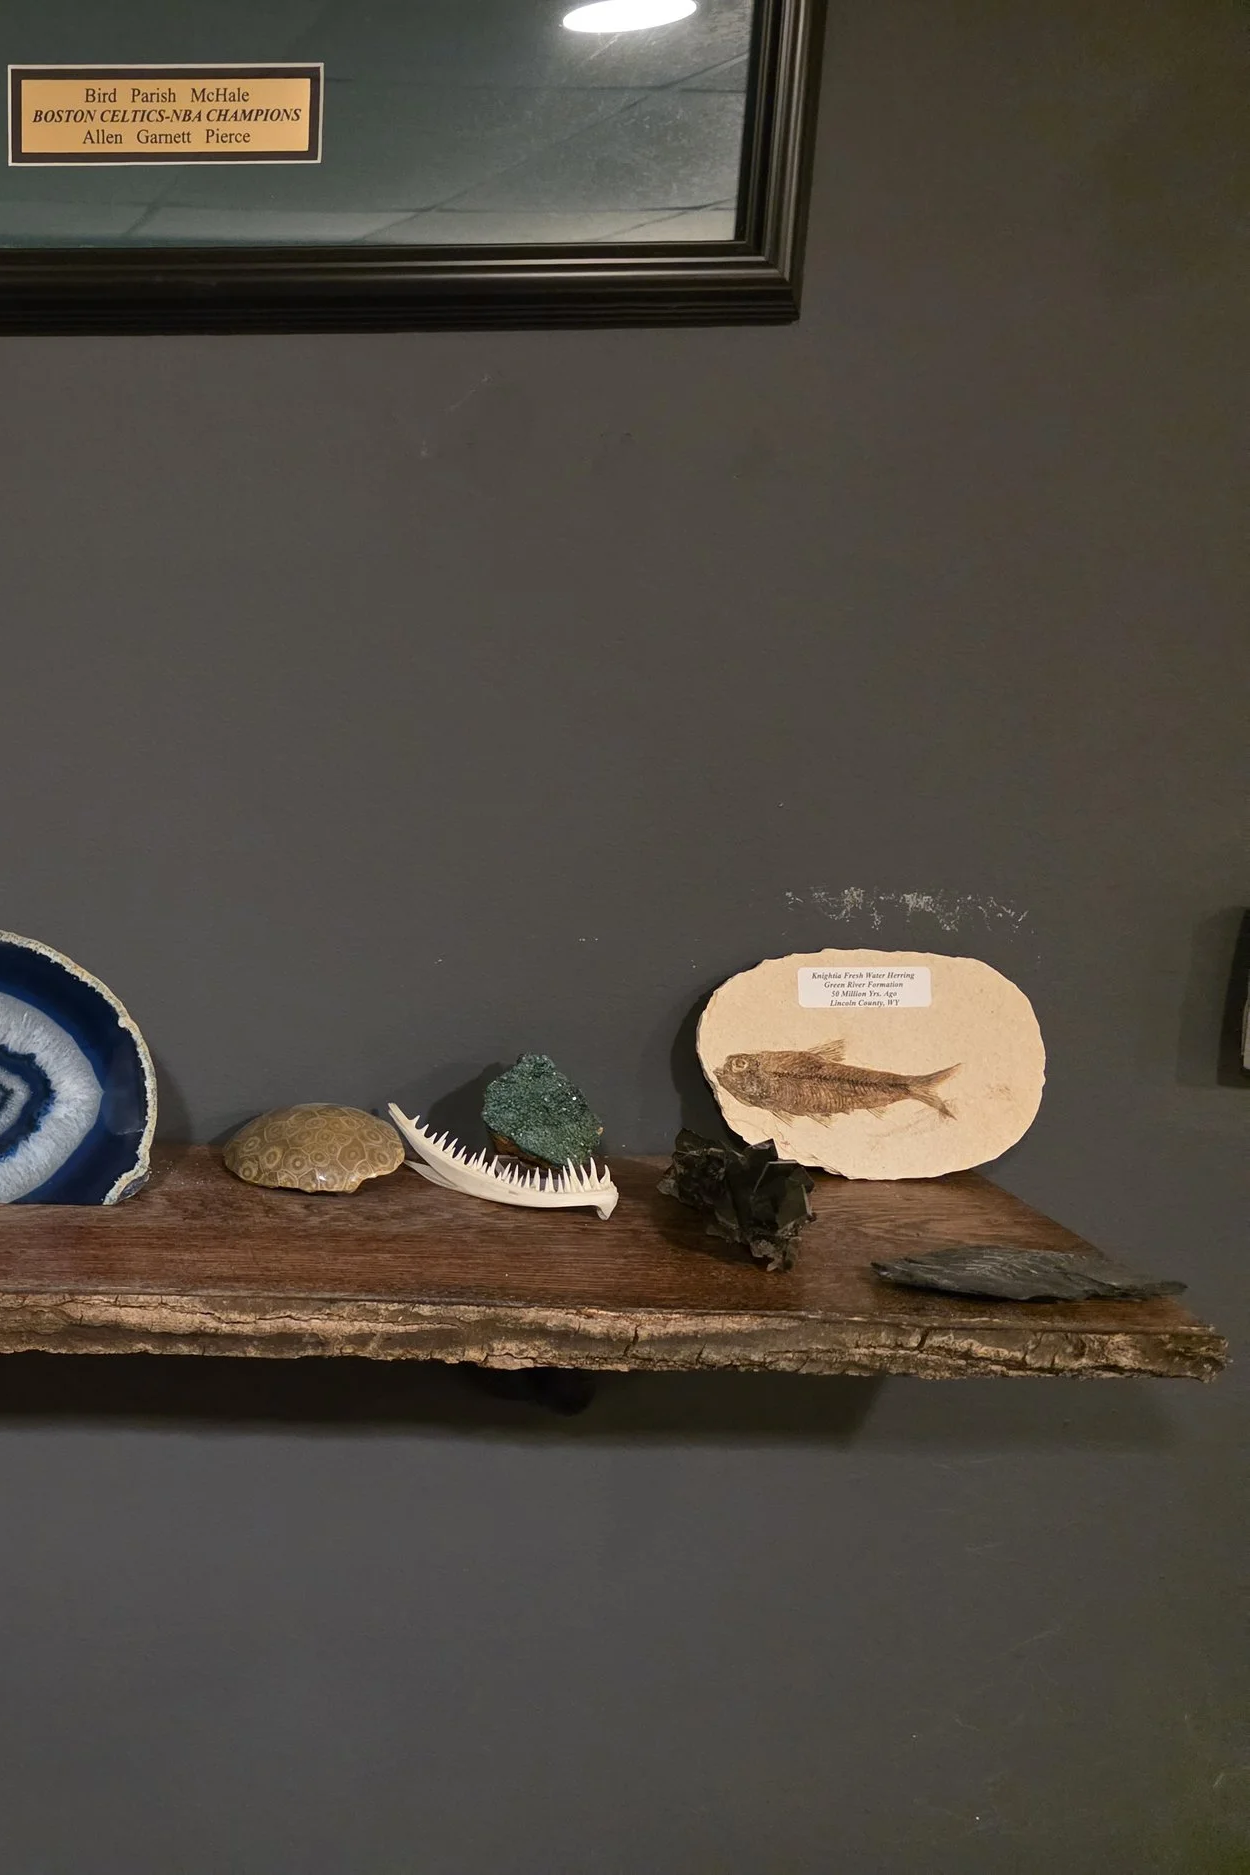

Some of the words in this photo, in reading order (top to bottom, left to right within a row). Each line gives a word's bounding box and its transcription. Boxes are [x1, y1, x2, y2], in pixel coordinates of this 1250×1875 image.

[84, 87, 118, 103] Bird
[130, 87, 176, 103] Parish
[190, 87, 250, 103] McHale
[32, 109, 97, 123] BOSTON
[100, 108, 202, 123] CELTICS-NBA
[206, 108, 302, 122] CHAMPIONS
[82, 129, 123, 144] Allen
[136, 129, 192, 144] Garnett
[205, 128, 251, 144] Pierce
[812, 972, 842, 980] Knightia
[887, 971, 915, 980] Herring
[869, 989, 882, 997] Yrs.
[884, 990, 898, 998] Ago
[830, 999, 857, 1007] Lincoln
[858, 999, 886, 1007] County,
